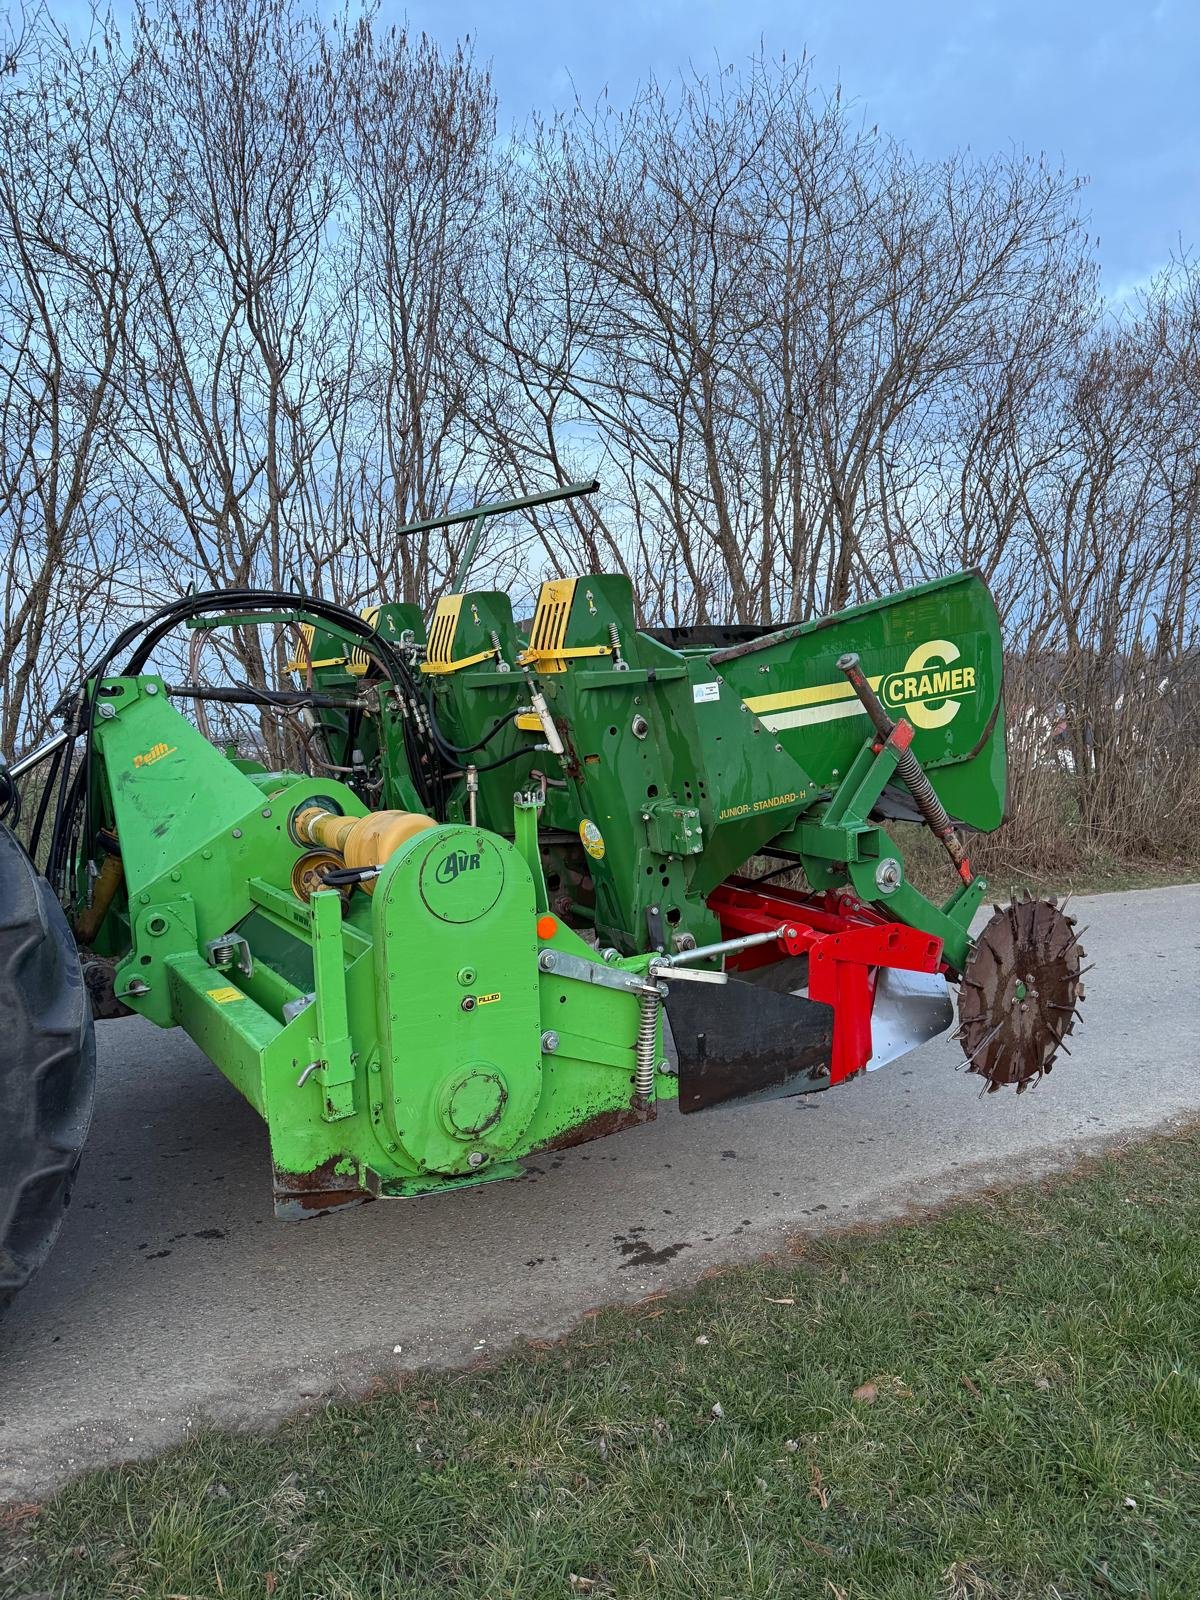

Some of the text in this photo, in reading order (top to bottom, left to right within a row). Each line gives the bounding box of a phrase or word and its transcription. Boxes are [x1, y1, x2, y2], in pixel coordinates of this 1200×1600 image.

[888, 667, 976, 701] CRAMER
[719, 805, 751, 820] JUNIOR-
[753, 792, 799, 811] STANDARD-
[438, 850, 480, 881] AVR
[478, 993, 499, 1004] FILLED
